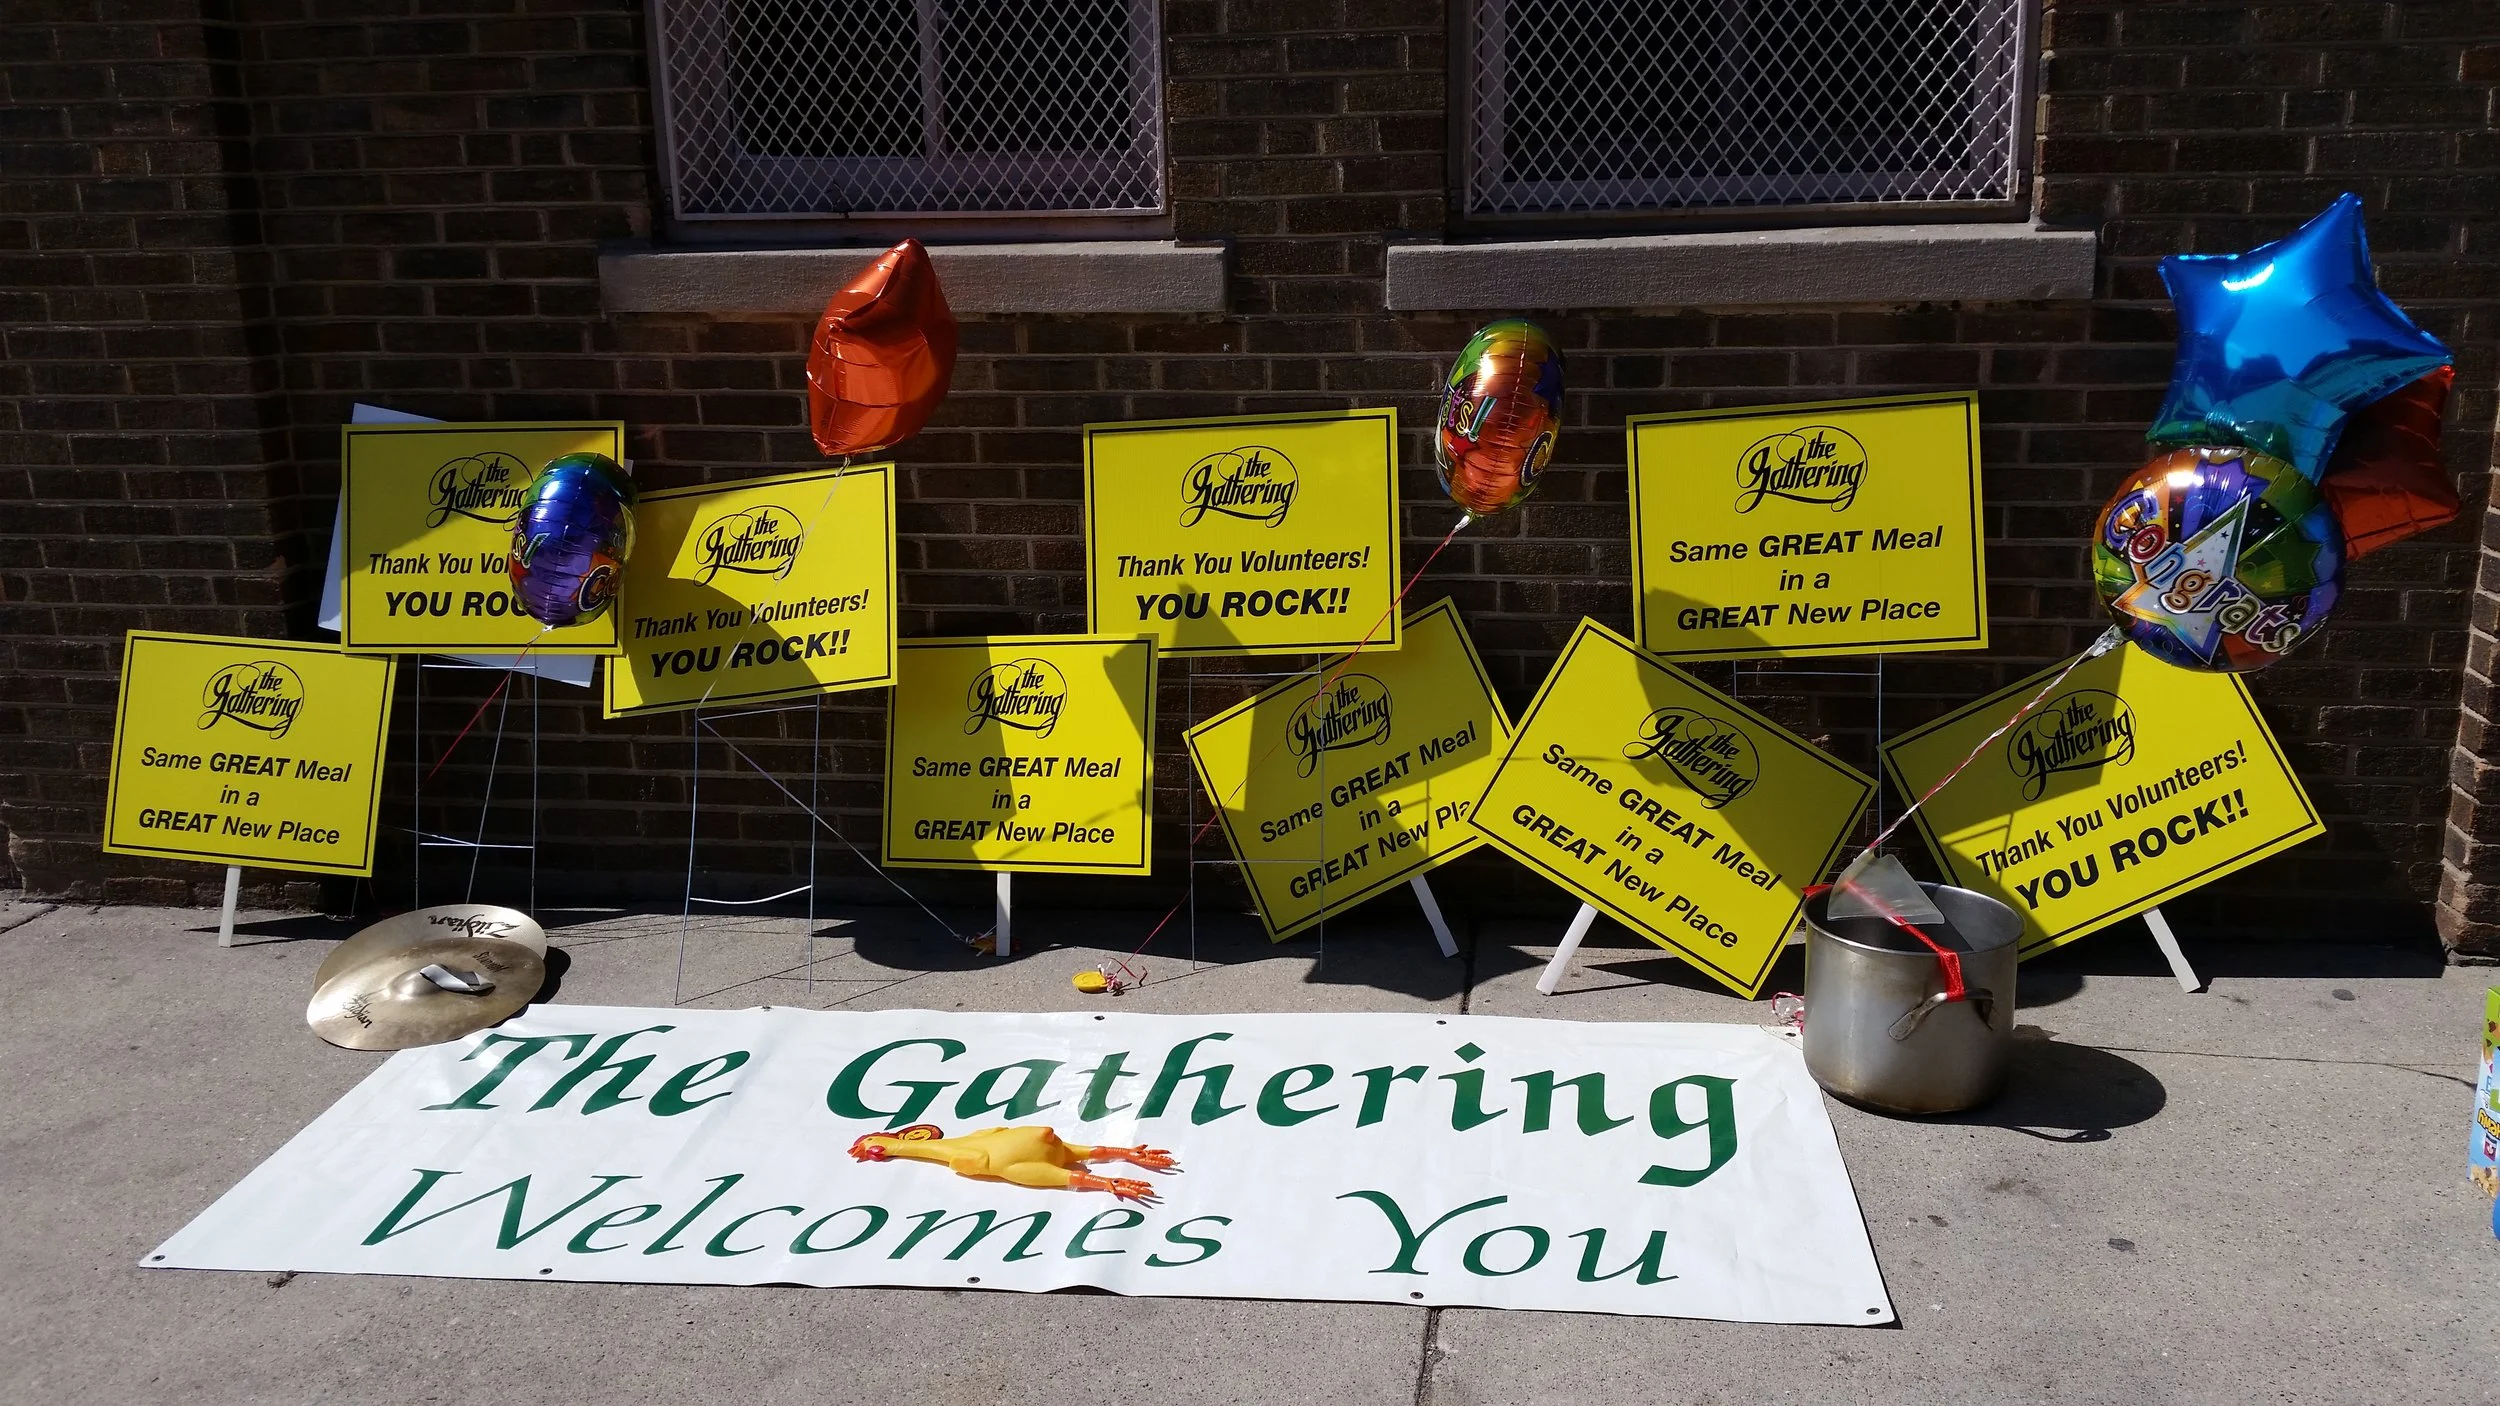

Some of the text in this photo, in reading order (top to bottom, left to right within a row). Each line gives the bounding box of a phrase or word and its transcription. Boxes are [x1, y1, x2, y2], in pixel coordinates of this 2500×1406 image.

[1806, 430, 1836, 460] the
[485, 456, 509, 483] the
[1244, 451, 1270, 478] the
[753, 510, 778, 536] the
[1669, 525, 1943, 562] Same GREAT Meal
[370, 553, 430, 574] Thank
[439, 553, 472, 573] You
[1118, 546, 1370, 577] Thank You Volunteers!
[1779, 569, 1829, 590] in a
[386, 592, 452, 616] YOU
[634, 589, 868, 638] Thank You Volunteers!
[1136, 588, 1350, 620] YOU ROCK!!
[1678, 598, 1940, 630] GREAT New Place
[651, 629, 850, 677] YOU ROCK!!
[258, 666, 283, 691] the
[1021, 663, 1044, 689] the
[1334, 681, 1361, 711] the
[2065, 696, 2097, 728] the
[1706, 733, 1739, 760] the
[141, 747, 352, 782] Same GREAT Meal
[912, 757, 1120, 777] Same GREAT Meal
[220, 785, 259, 806] in a
[1260, 720, 1476, 842] Same GREAT Meal
[992, 789, 1030, 809] in a
[1976, 740, 2246, 877] Thank You Volunteers!
[139, 809, 339, 844] GREAT New Place
[1359, 800, 1401, 831] in a
[1543, 744, 1782, 891] Same GREAT Meal
[914, 820, 1114, 843] GREAT New Place
[1615, 826, 1663, 864] in a
[1290, 843, 1369, 898] GREAT
[1378, 820, 1428, 857] New
[2015, 789, 2248, 909] YOU ROCK!!
[1513, 805, 1737, 947] GREAT New Place
[421, 1026, 1738, 1187] The Gathering
[361, 1168, 1679, 1286] Welcomes You
